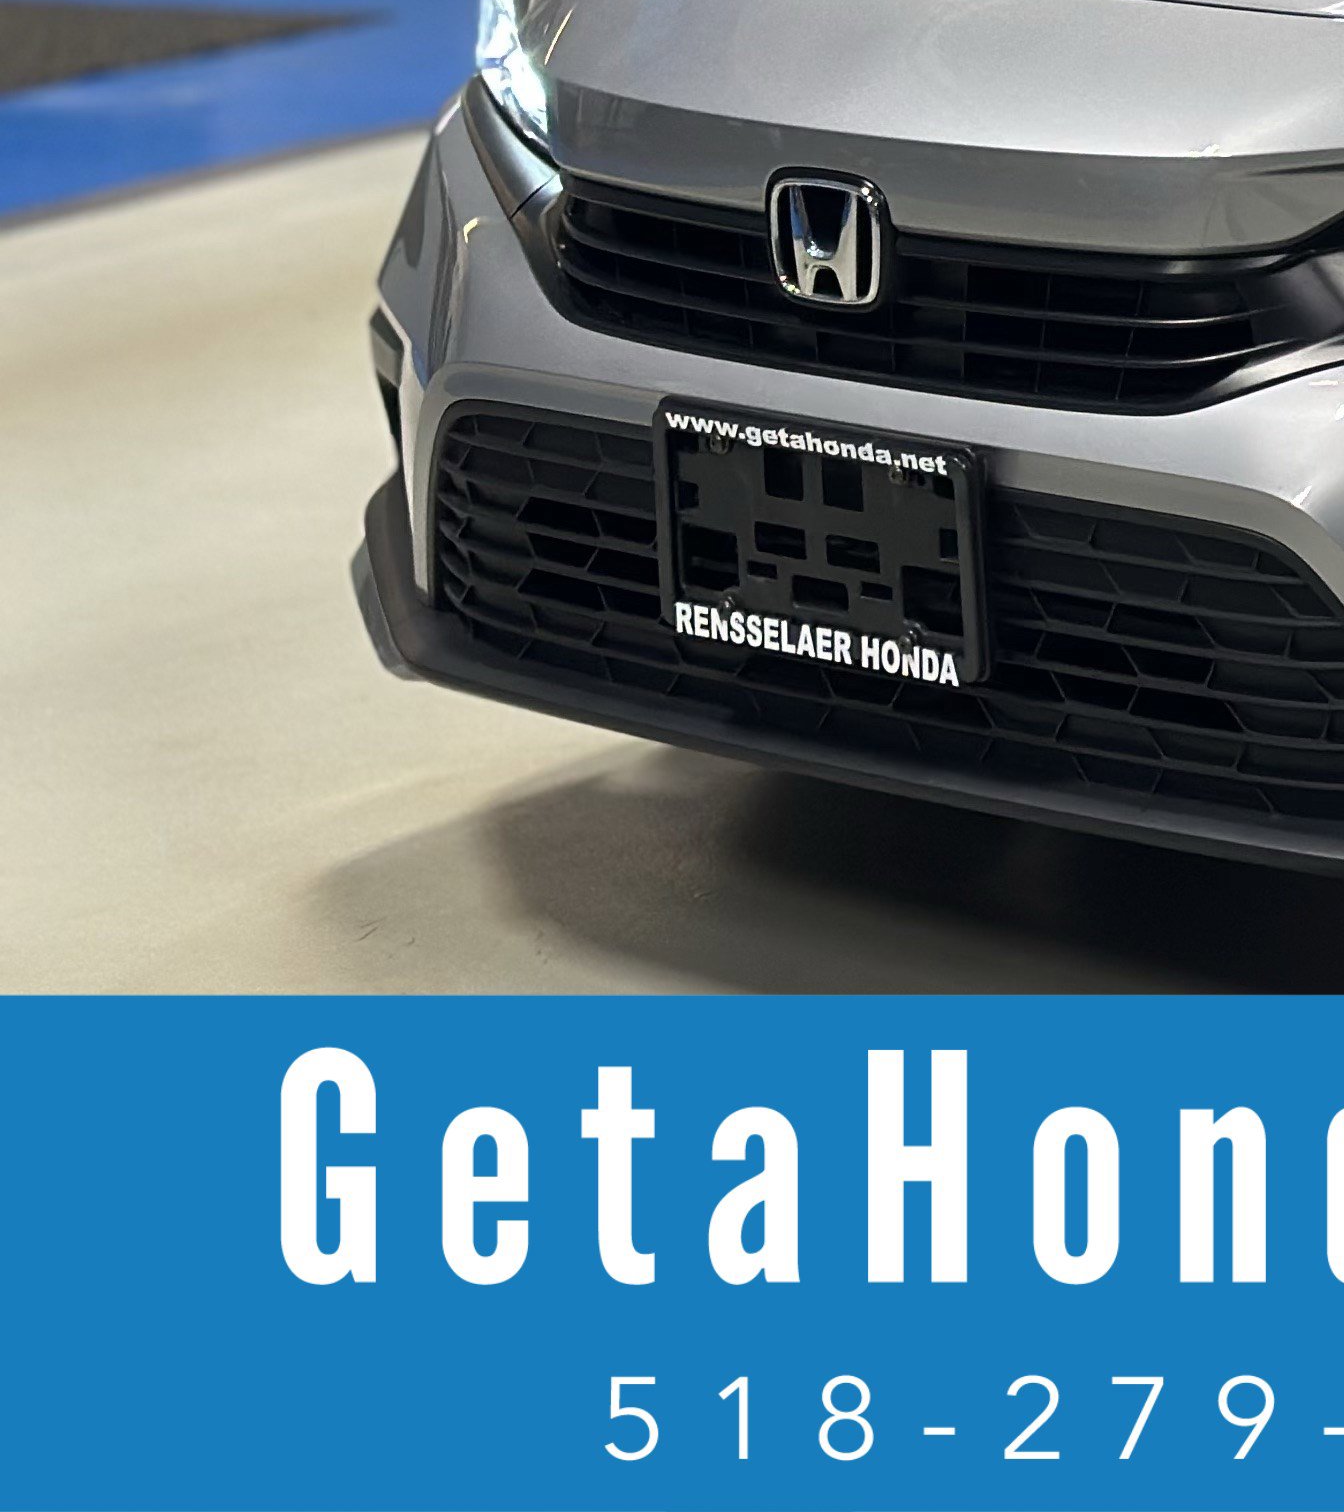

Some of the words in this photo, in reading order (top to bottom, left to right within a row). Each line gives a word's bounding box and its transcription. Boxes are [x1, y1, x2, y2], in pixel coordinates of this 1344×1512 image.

[665, 411, 948, 476] www.getahonda.net
[674, 601, 853, 666] RENSSELAER
[860, 635, 960, 688] HONDA
